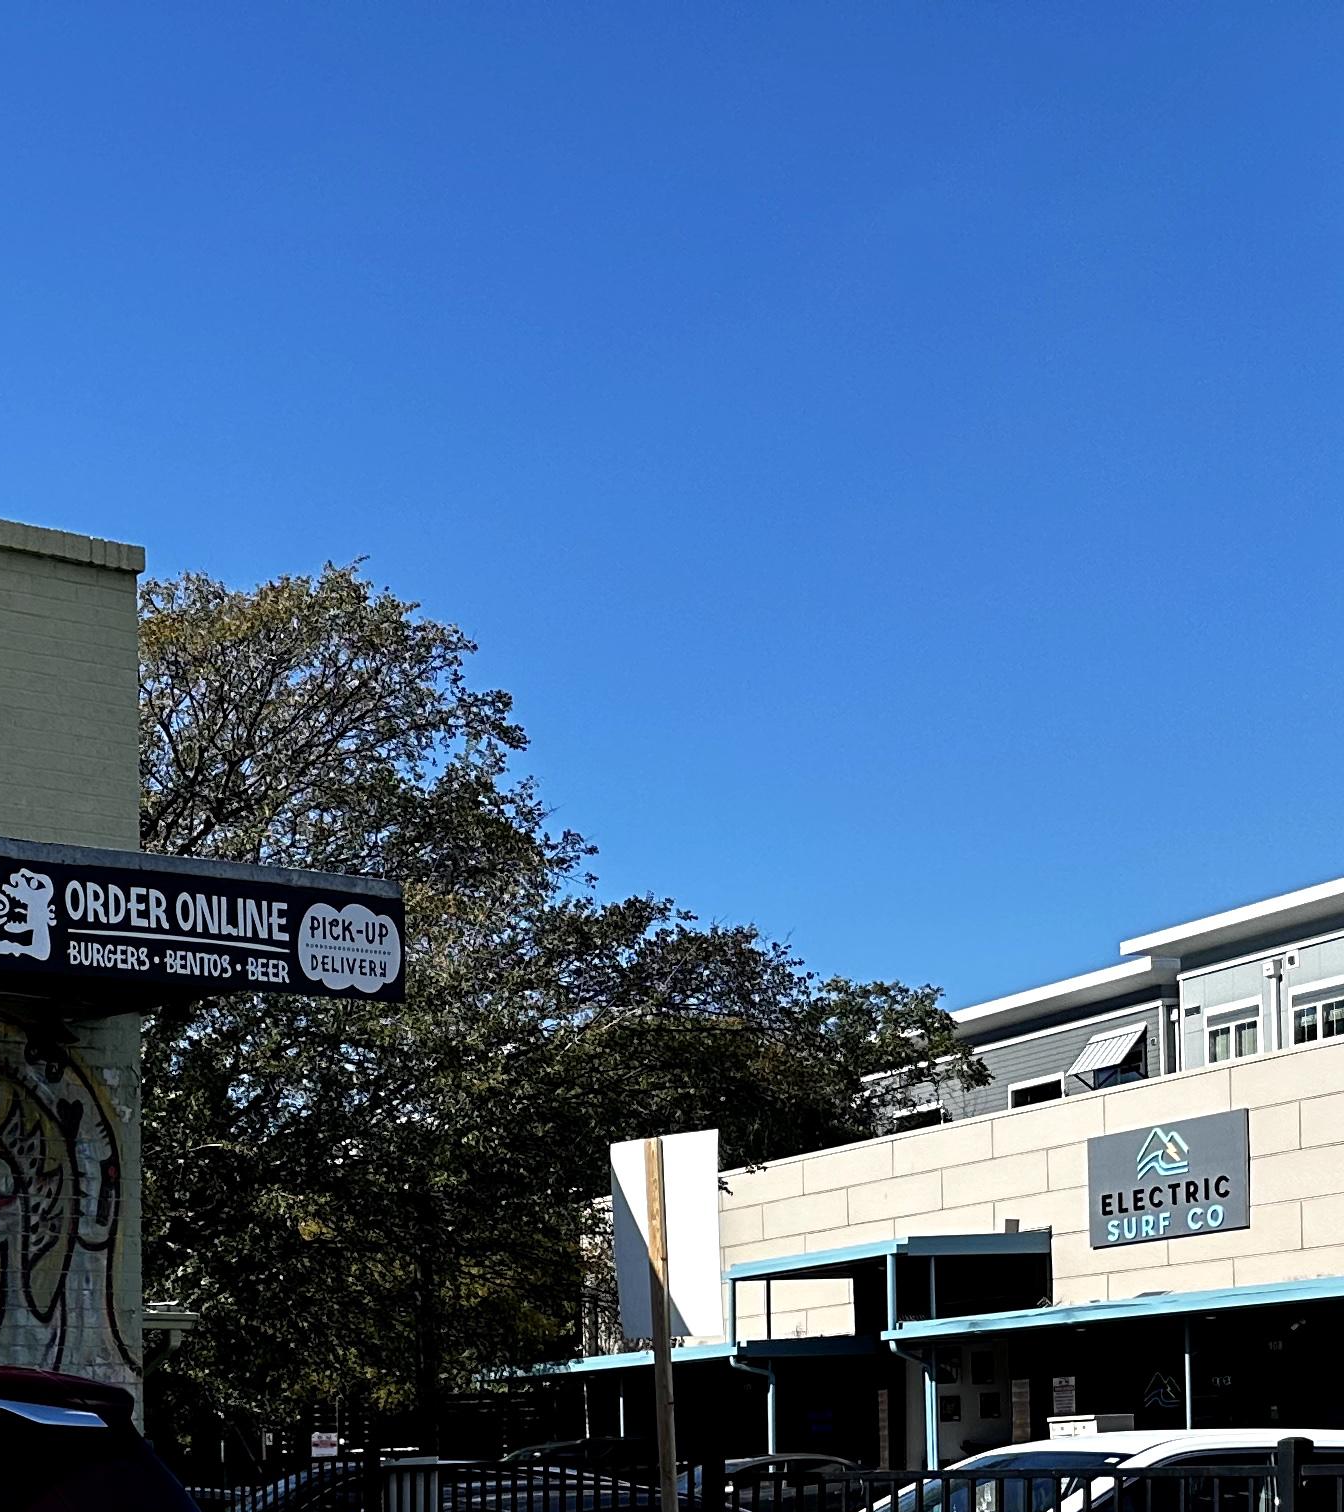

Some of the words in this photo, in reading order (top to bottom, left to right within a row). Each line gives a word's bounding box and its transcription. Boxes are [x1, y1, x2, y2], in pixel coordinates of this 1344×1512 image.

[64, 879, 169, 930] ORDER
[175, 892, 290, 941] ONLINE
[308, 914, 390, 946] PICK-UP
[67, 940, 150, 971] BURGERS
[164, 949, 232, 978] BENTOS
[245, 957, 291, 984] BEER
[310, 953, 388, 978] DELIVERY
[1101, 1175, 1231, 1217] ELECTRIC
[1108, 1211, 1172, 1242] SURF
[1187, 1204, 1225, 1231] CO
